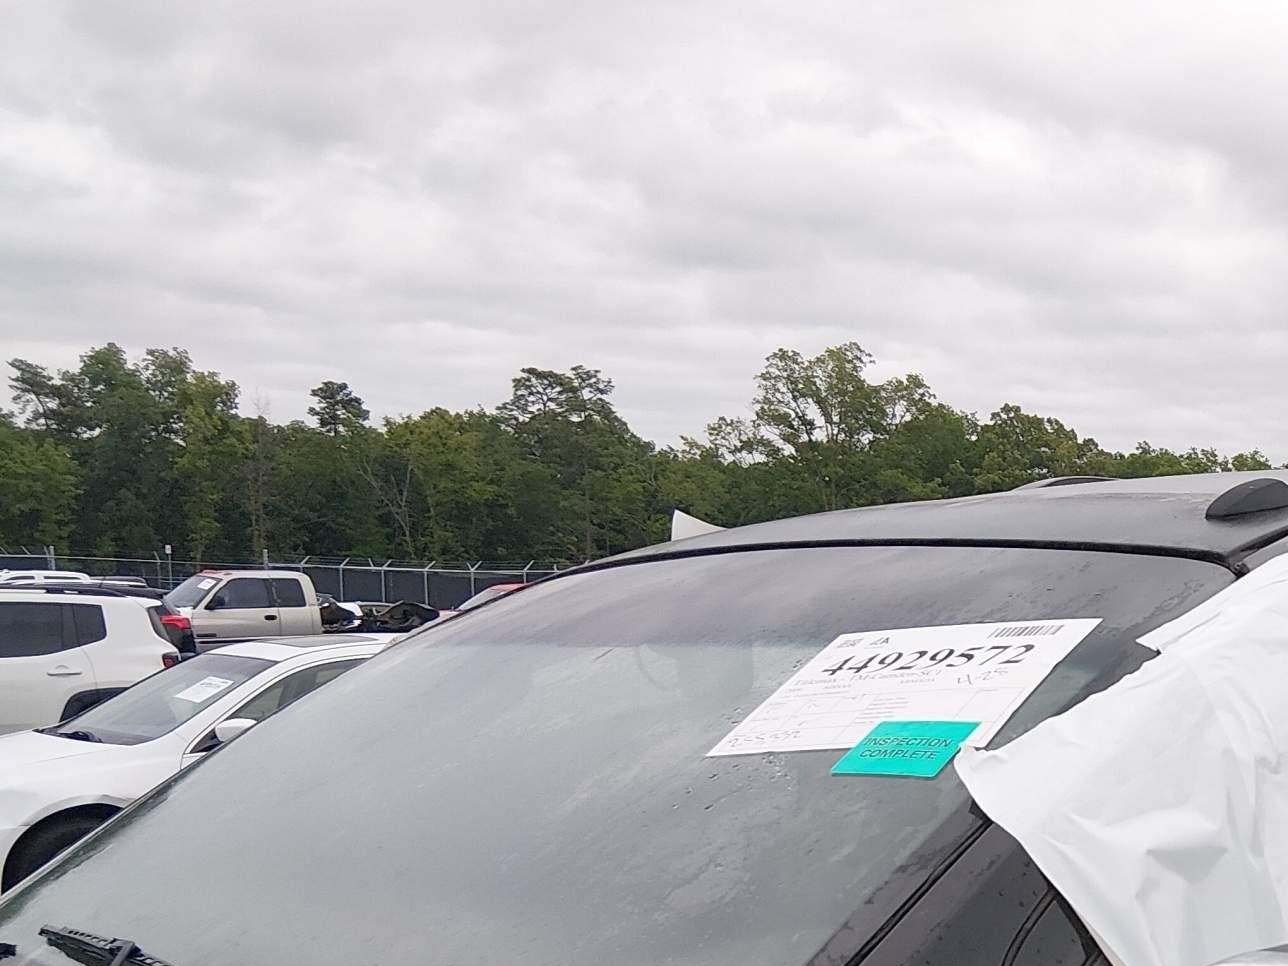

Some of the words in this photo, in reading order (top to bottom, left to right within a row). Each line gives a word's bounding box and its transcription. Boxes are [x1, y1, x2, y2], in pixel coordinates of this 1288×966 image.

[822, 644, 1036, 676] 44929572
[863, 736, 953, 749] INSPECTION
[859, 748, 938, 761] COMPLETE
